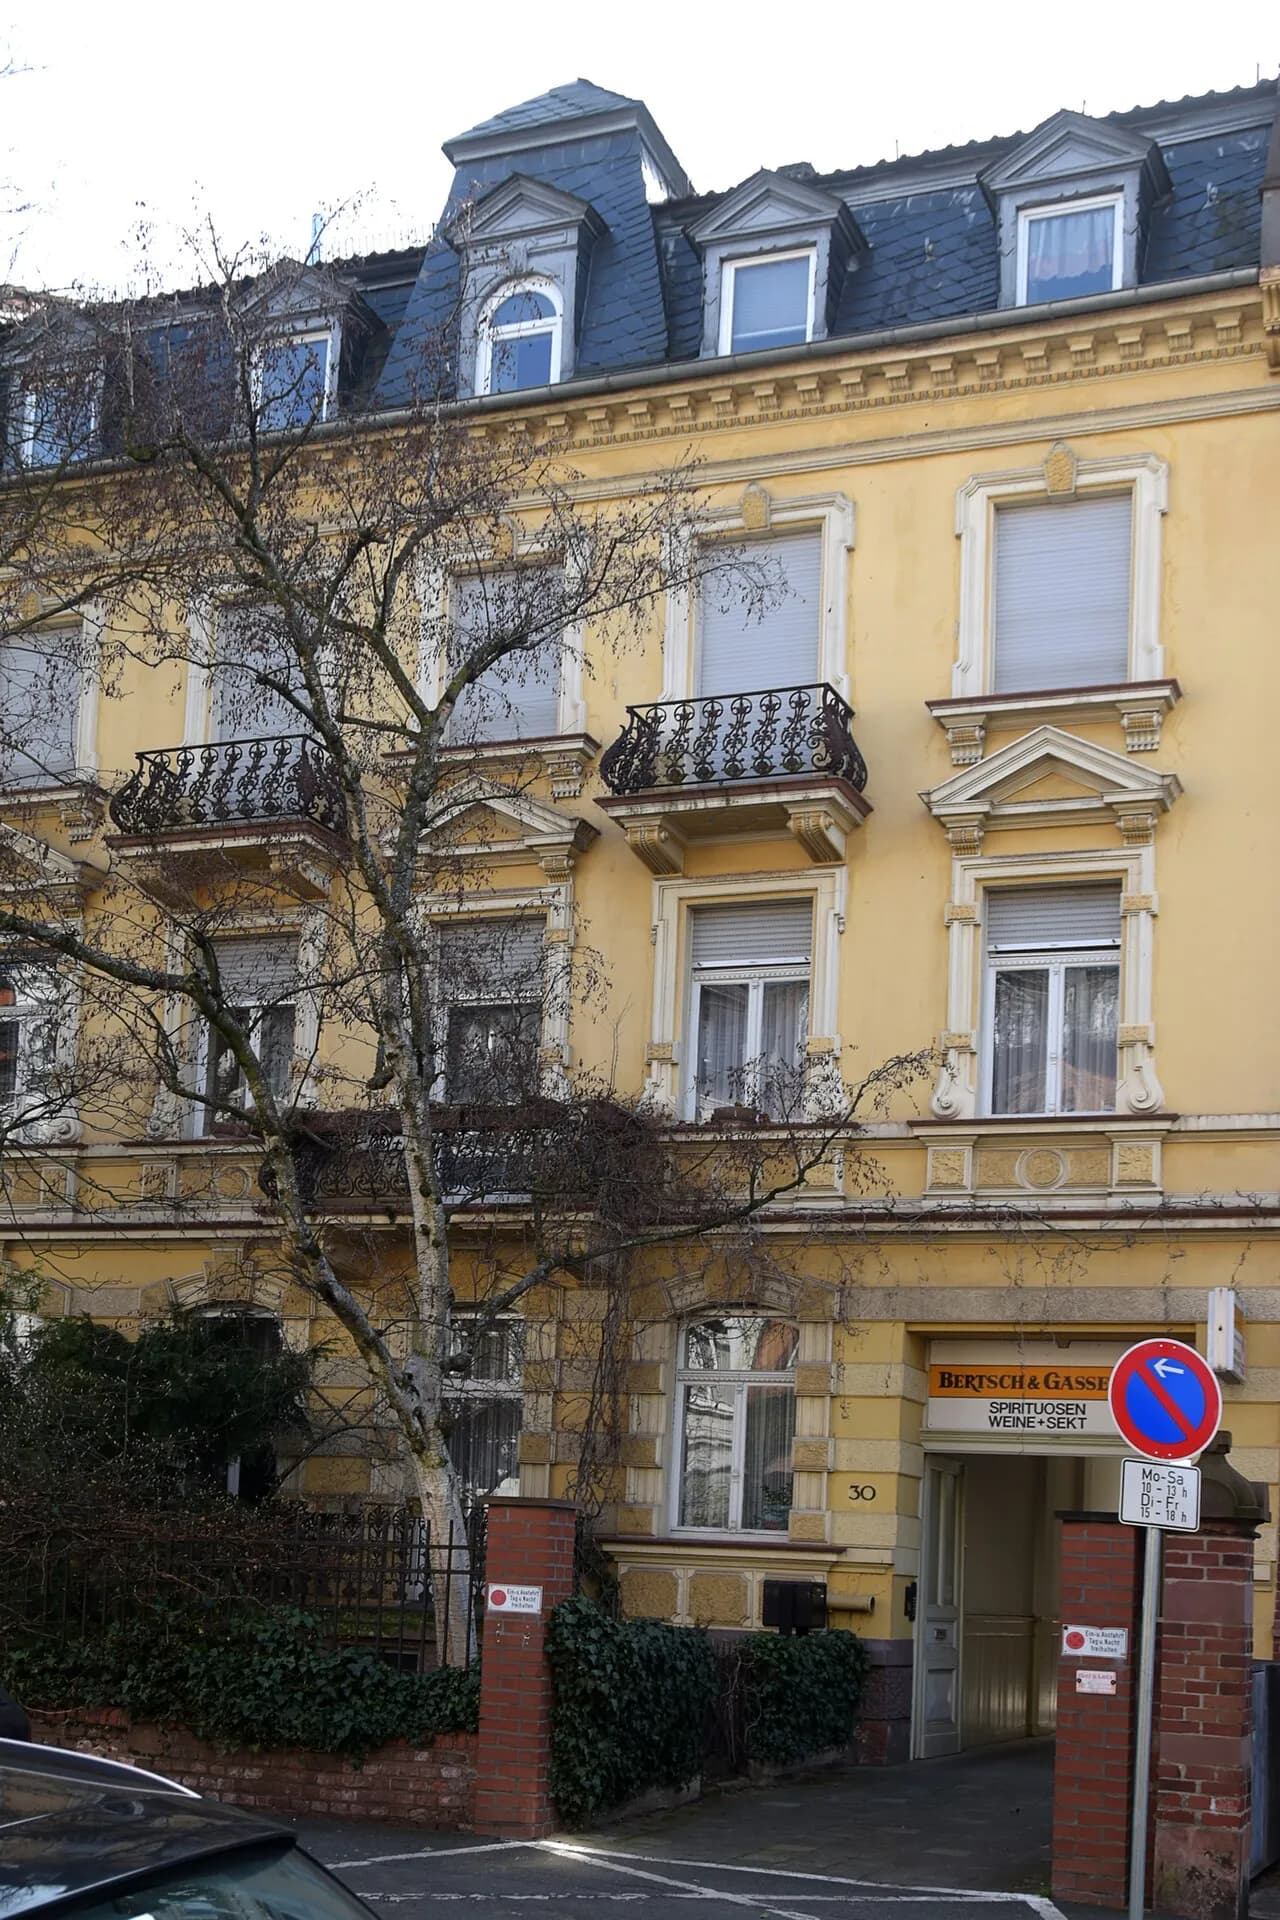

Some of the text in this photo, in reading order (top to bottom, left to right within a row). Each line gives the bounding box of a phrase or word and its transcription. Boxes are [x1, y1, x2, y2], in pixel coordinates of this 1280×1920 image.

[938, 1371, 1024, 1392] BERTSCH
[1027, 1376, 1040, 1390] &
[989, 1401, 1086, 1416] SPIRITUOSEN
[1142, 1468, 1184, 1485] Mo-Sa
[848, 1485, 876, 1501] 30
[1142, 1482, 1152, 1494] 10
[1167, 1485, 1177, 1497] 13
[1182, 1486, 1188, 1498] h
[1140, 1507, 1150, 1518] 15
[1166, 1510, 1176, 1521] 18
[1181, 1511, 1187, 1522] h
